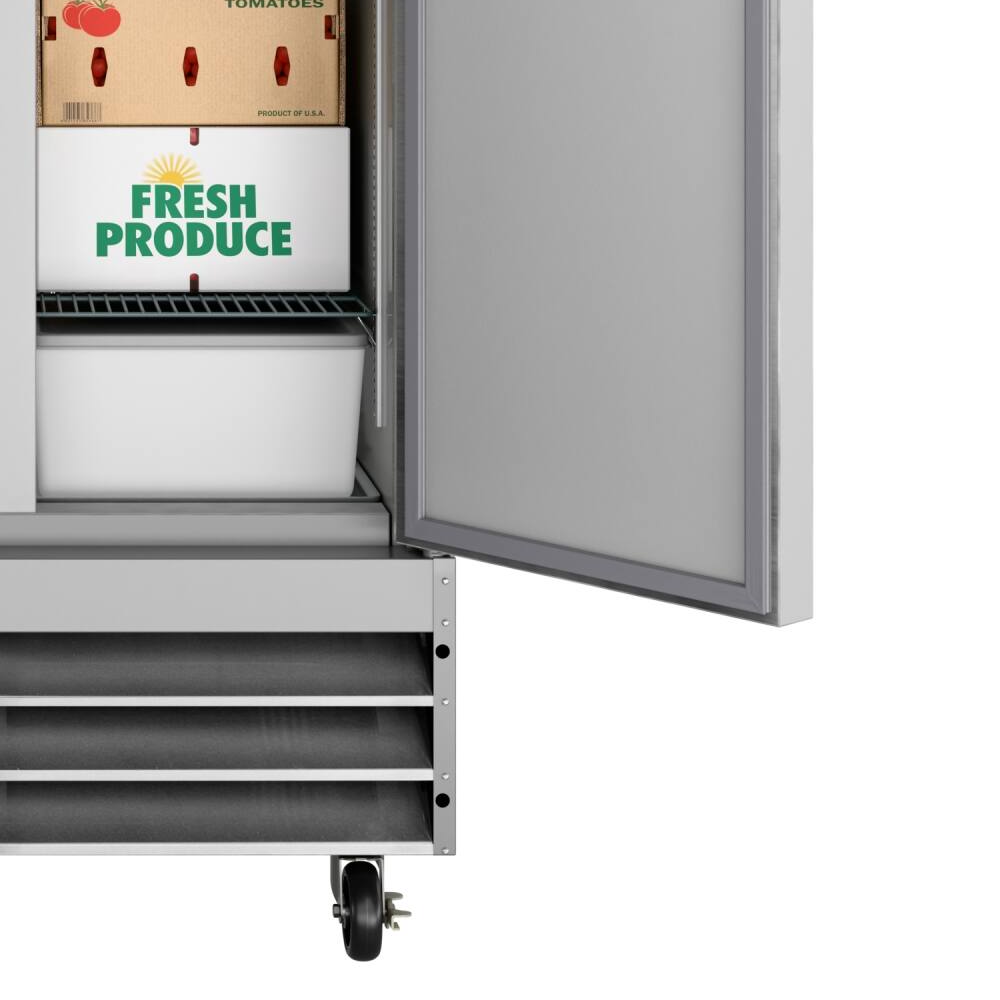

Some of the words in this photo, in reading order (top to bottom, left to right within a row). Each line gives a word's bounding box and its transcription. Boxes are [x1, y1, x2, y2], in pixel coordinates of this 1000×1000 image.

[257, 109, 292, 117] PRODUCT
[293, 109, 303, 117] OF
[304, 109, 325, 117] U.S.A.
[131, 184, 257, 219] FRESH
[96, 221, 293, 257] PRODUCE
